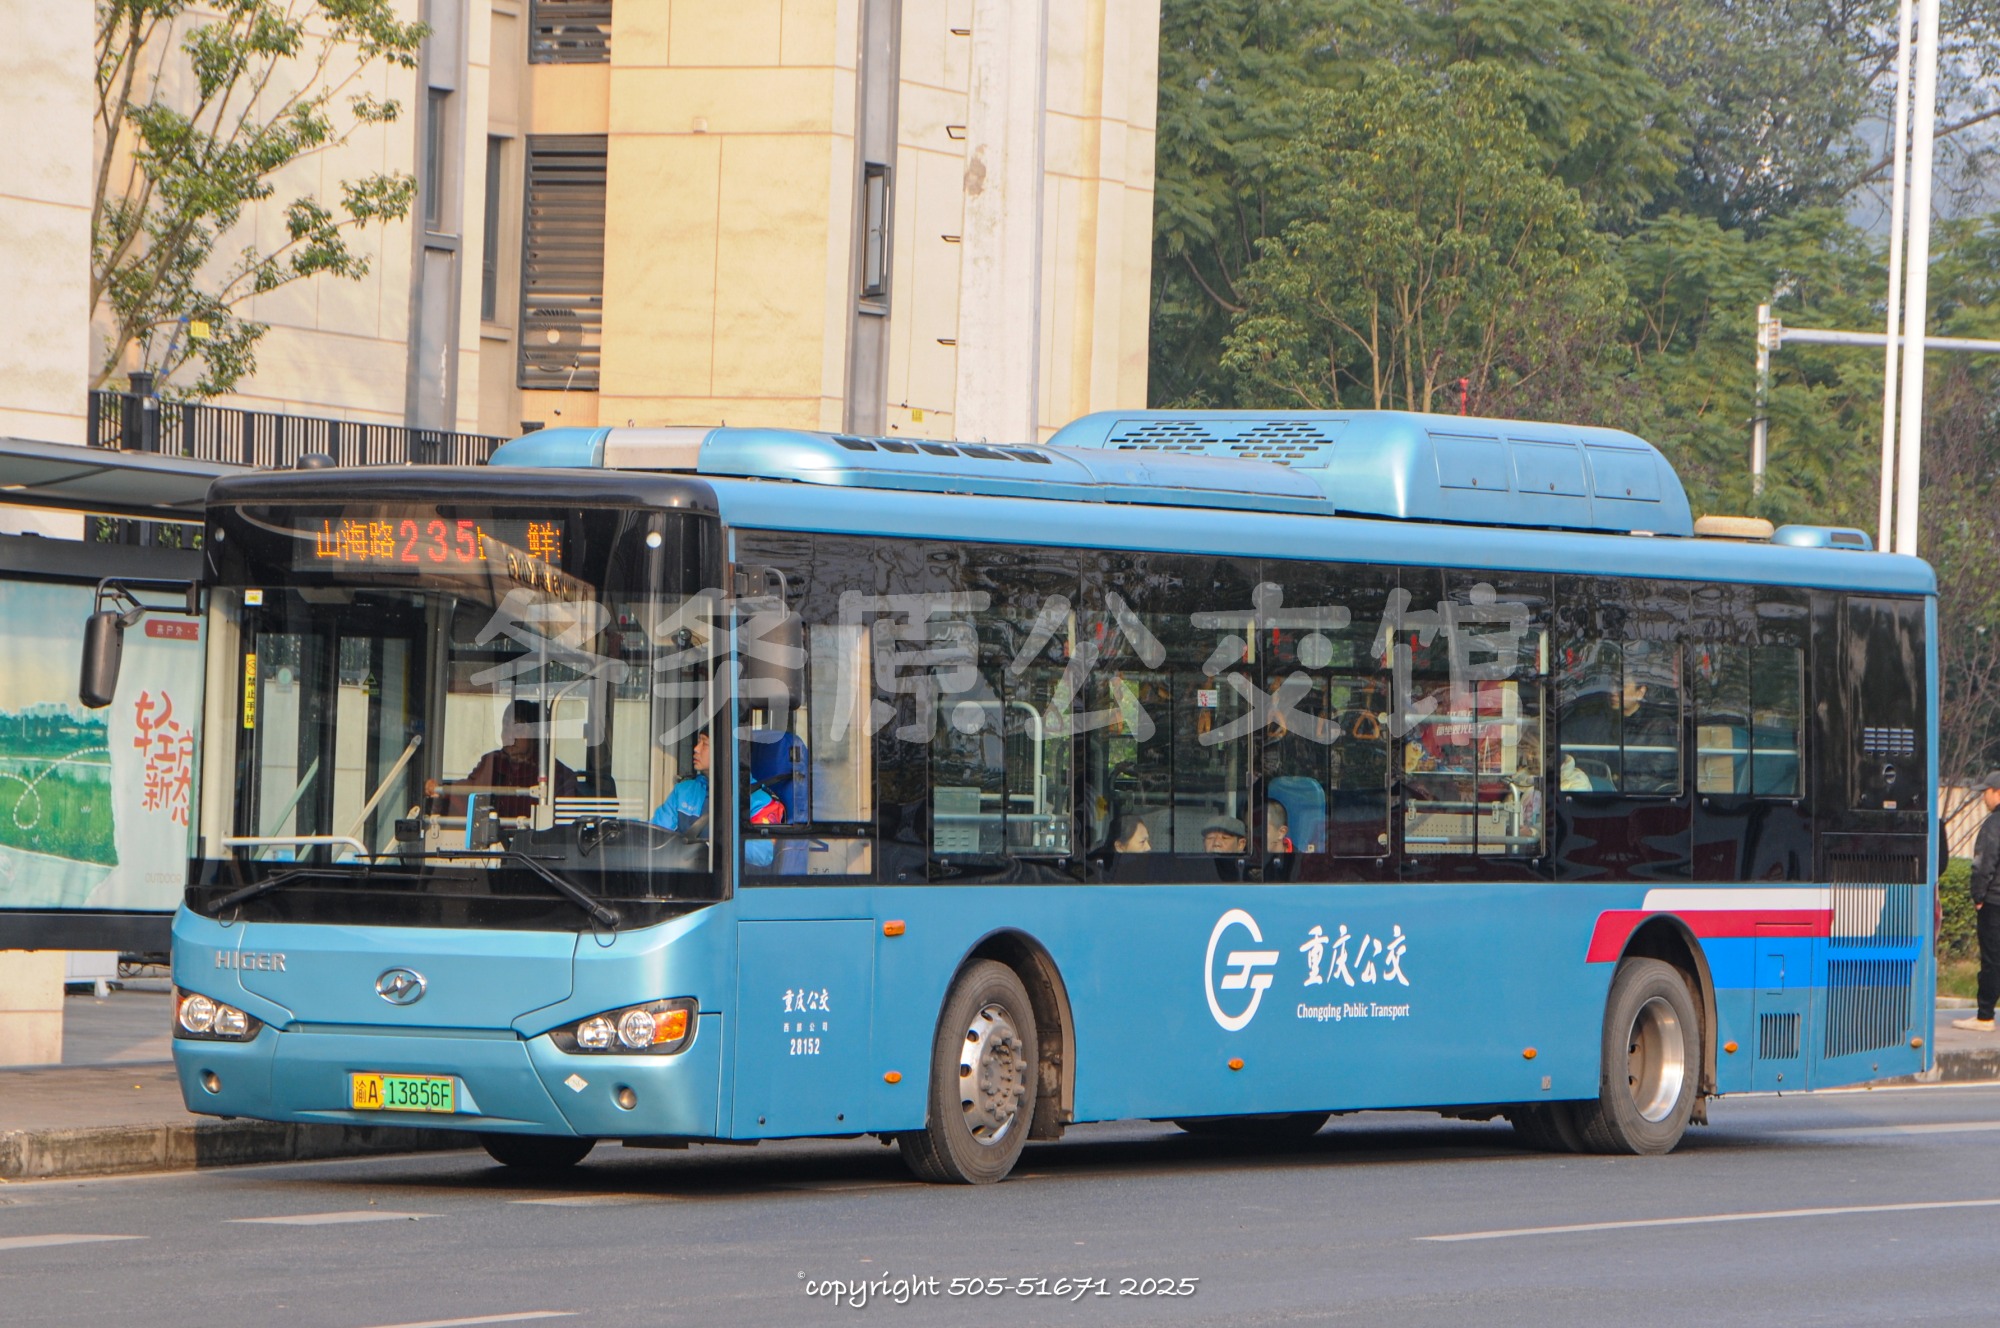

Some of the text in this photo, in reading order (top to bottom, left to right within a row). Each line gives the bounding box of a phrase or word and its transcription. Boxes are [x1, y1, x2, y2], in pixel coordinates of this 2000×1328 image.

[317, 519, 395, 560] 山海路
[400, 519, 476, 562] 235
[527, 521, 560, 563] 鲜
[215, 950, 287, 972] HIGER
[1299, 924, 1410, 988] 重庆公交
[782, 988, 830, 1013] 重庆公交
[1297, 1003, 1410, 1022] Chongqing Public Transport
[790, 1038, 820, 1056] 28152
